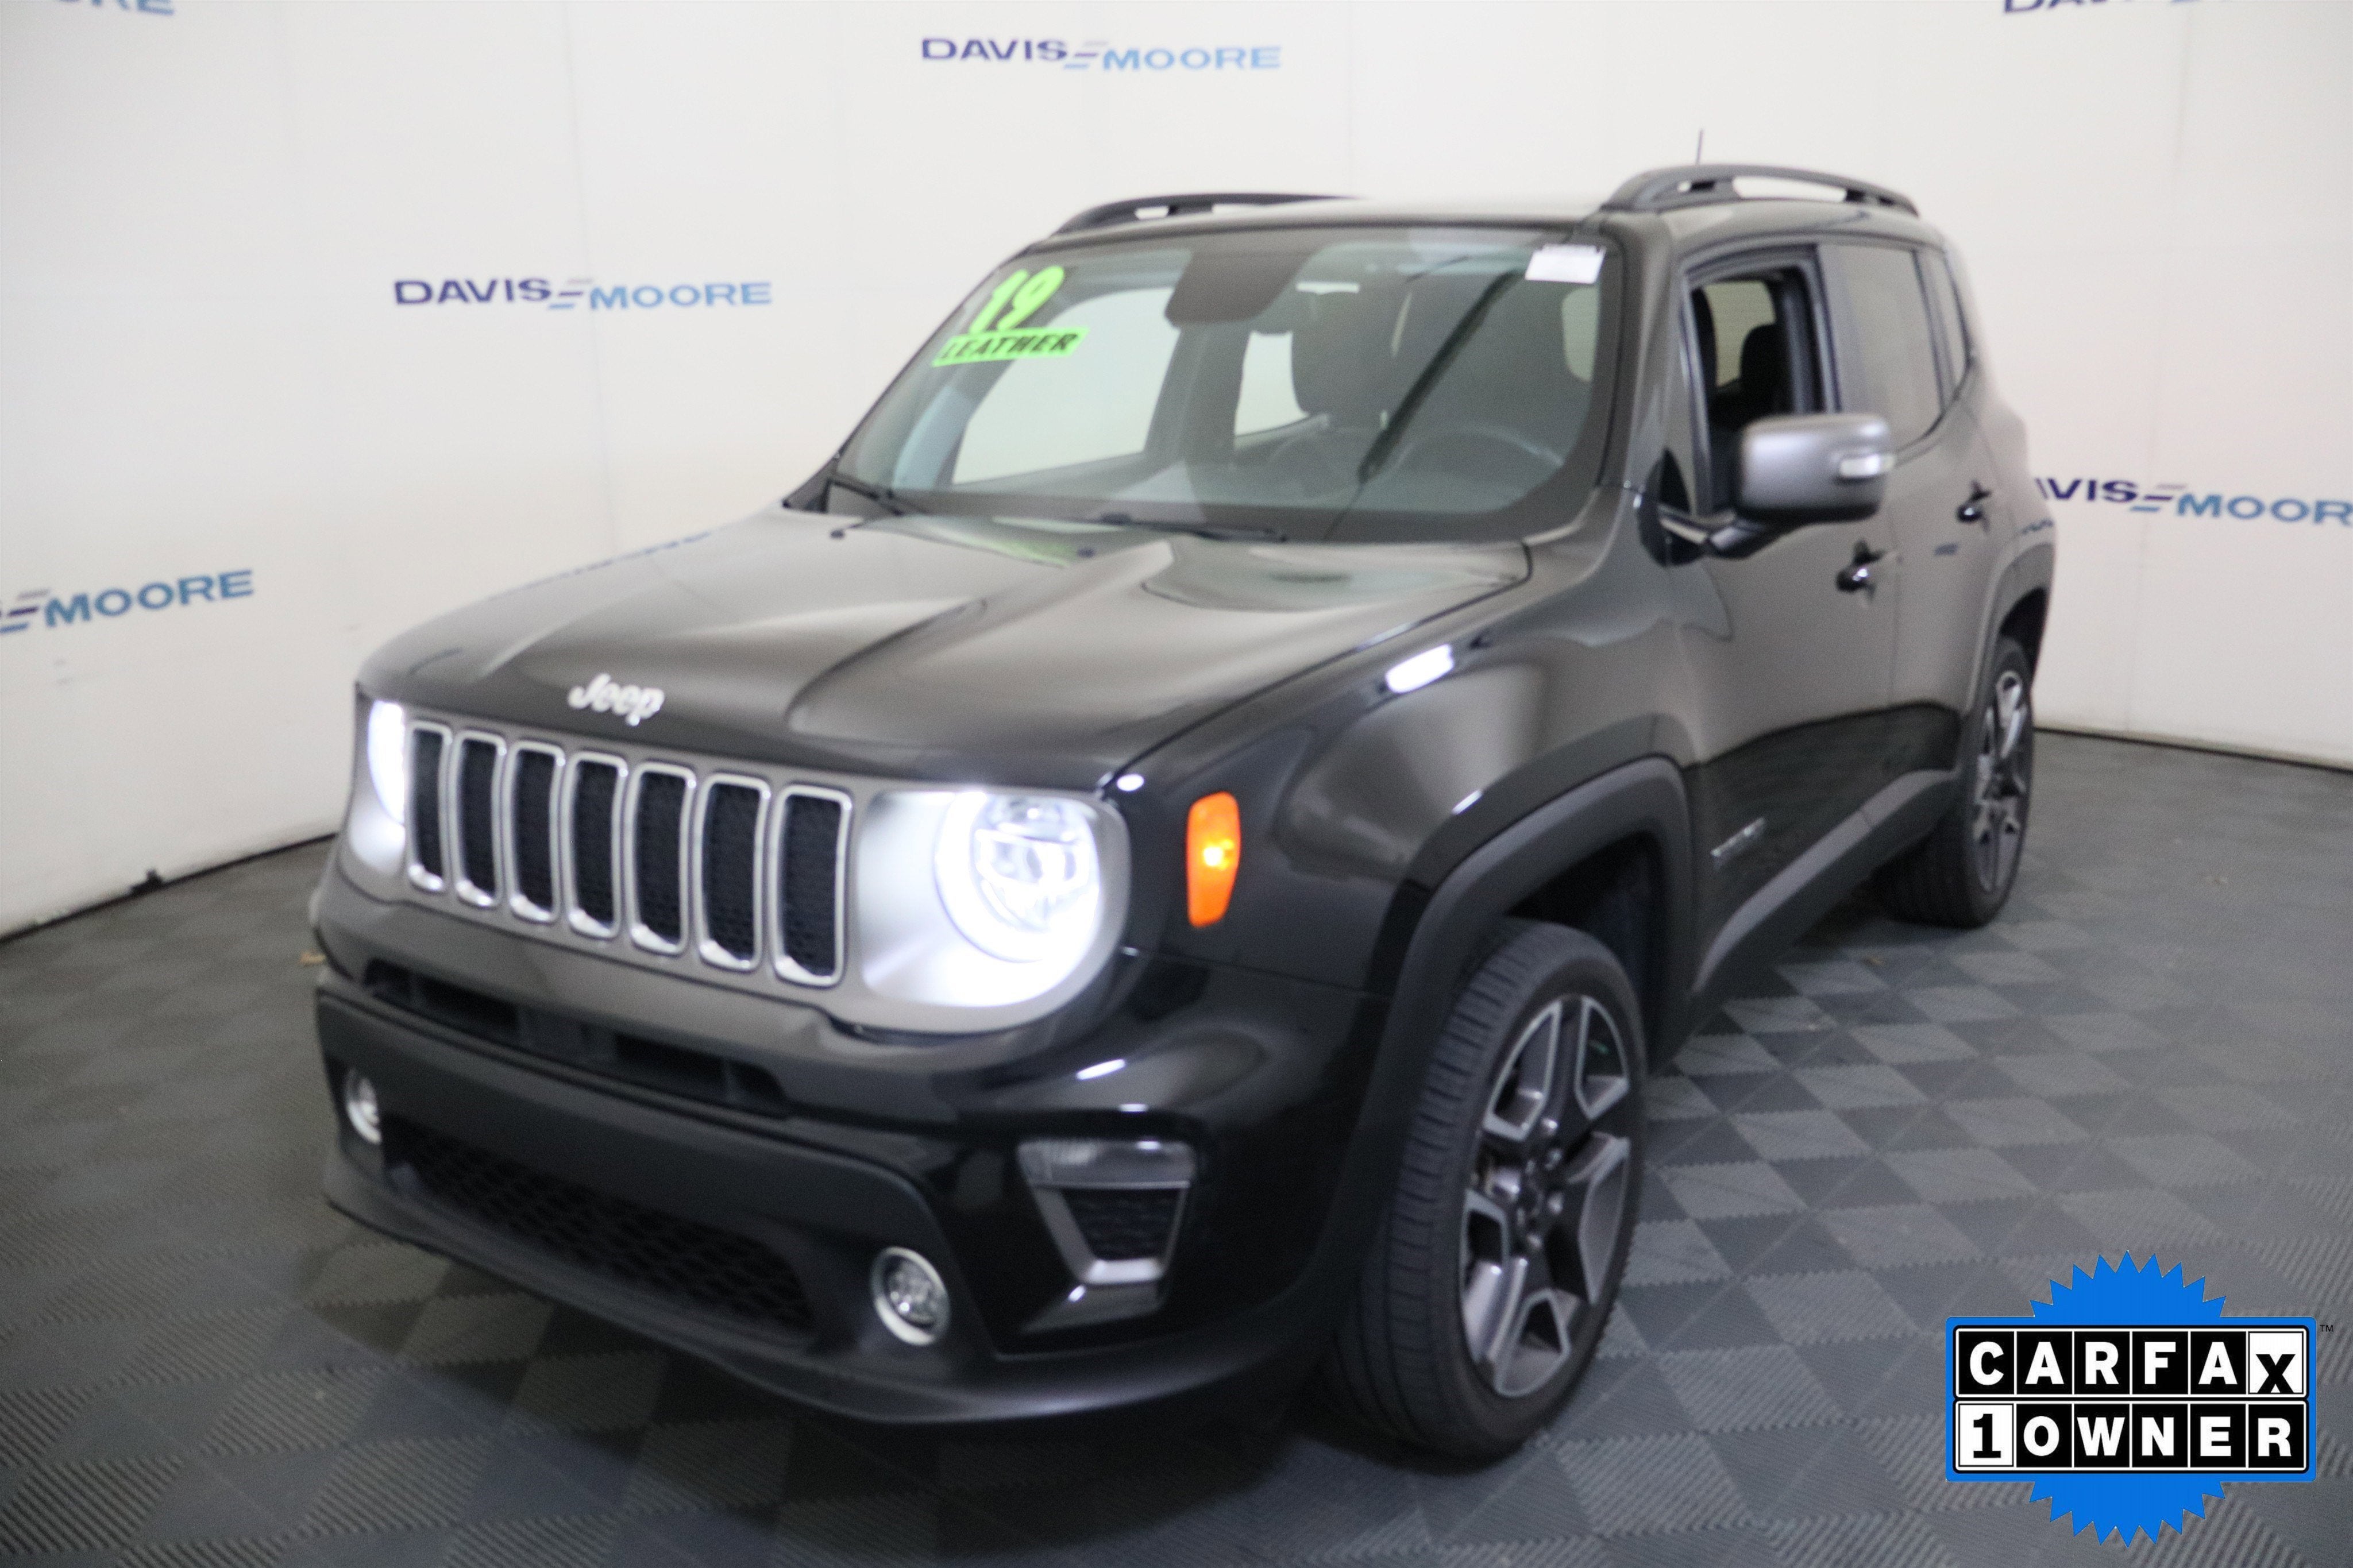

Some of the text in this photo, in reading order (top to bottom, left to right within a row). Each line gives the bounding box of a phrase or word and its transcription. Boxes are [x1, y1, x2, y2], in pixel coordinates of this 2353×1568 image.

[921, 38, 1282, 71] DAVIS MOORE
[394, 279, 772, 311] DAVIS MOORE
[968, 265, 1064, 334] 19
[940, 333, 1078, 360] LEATHER
[44, 569, 254, 628] MOORE
[568, 673, 665, 726] Jeep
